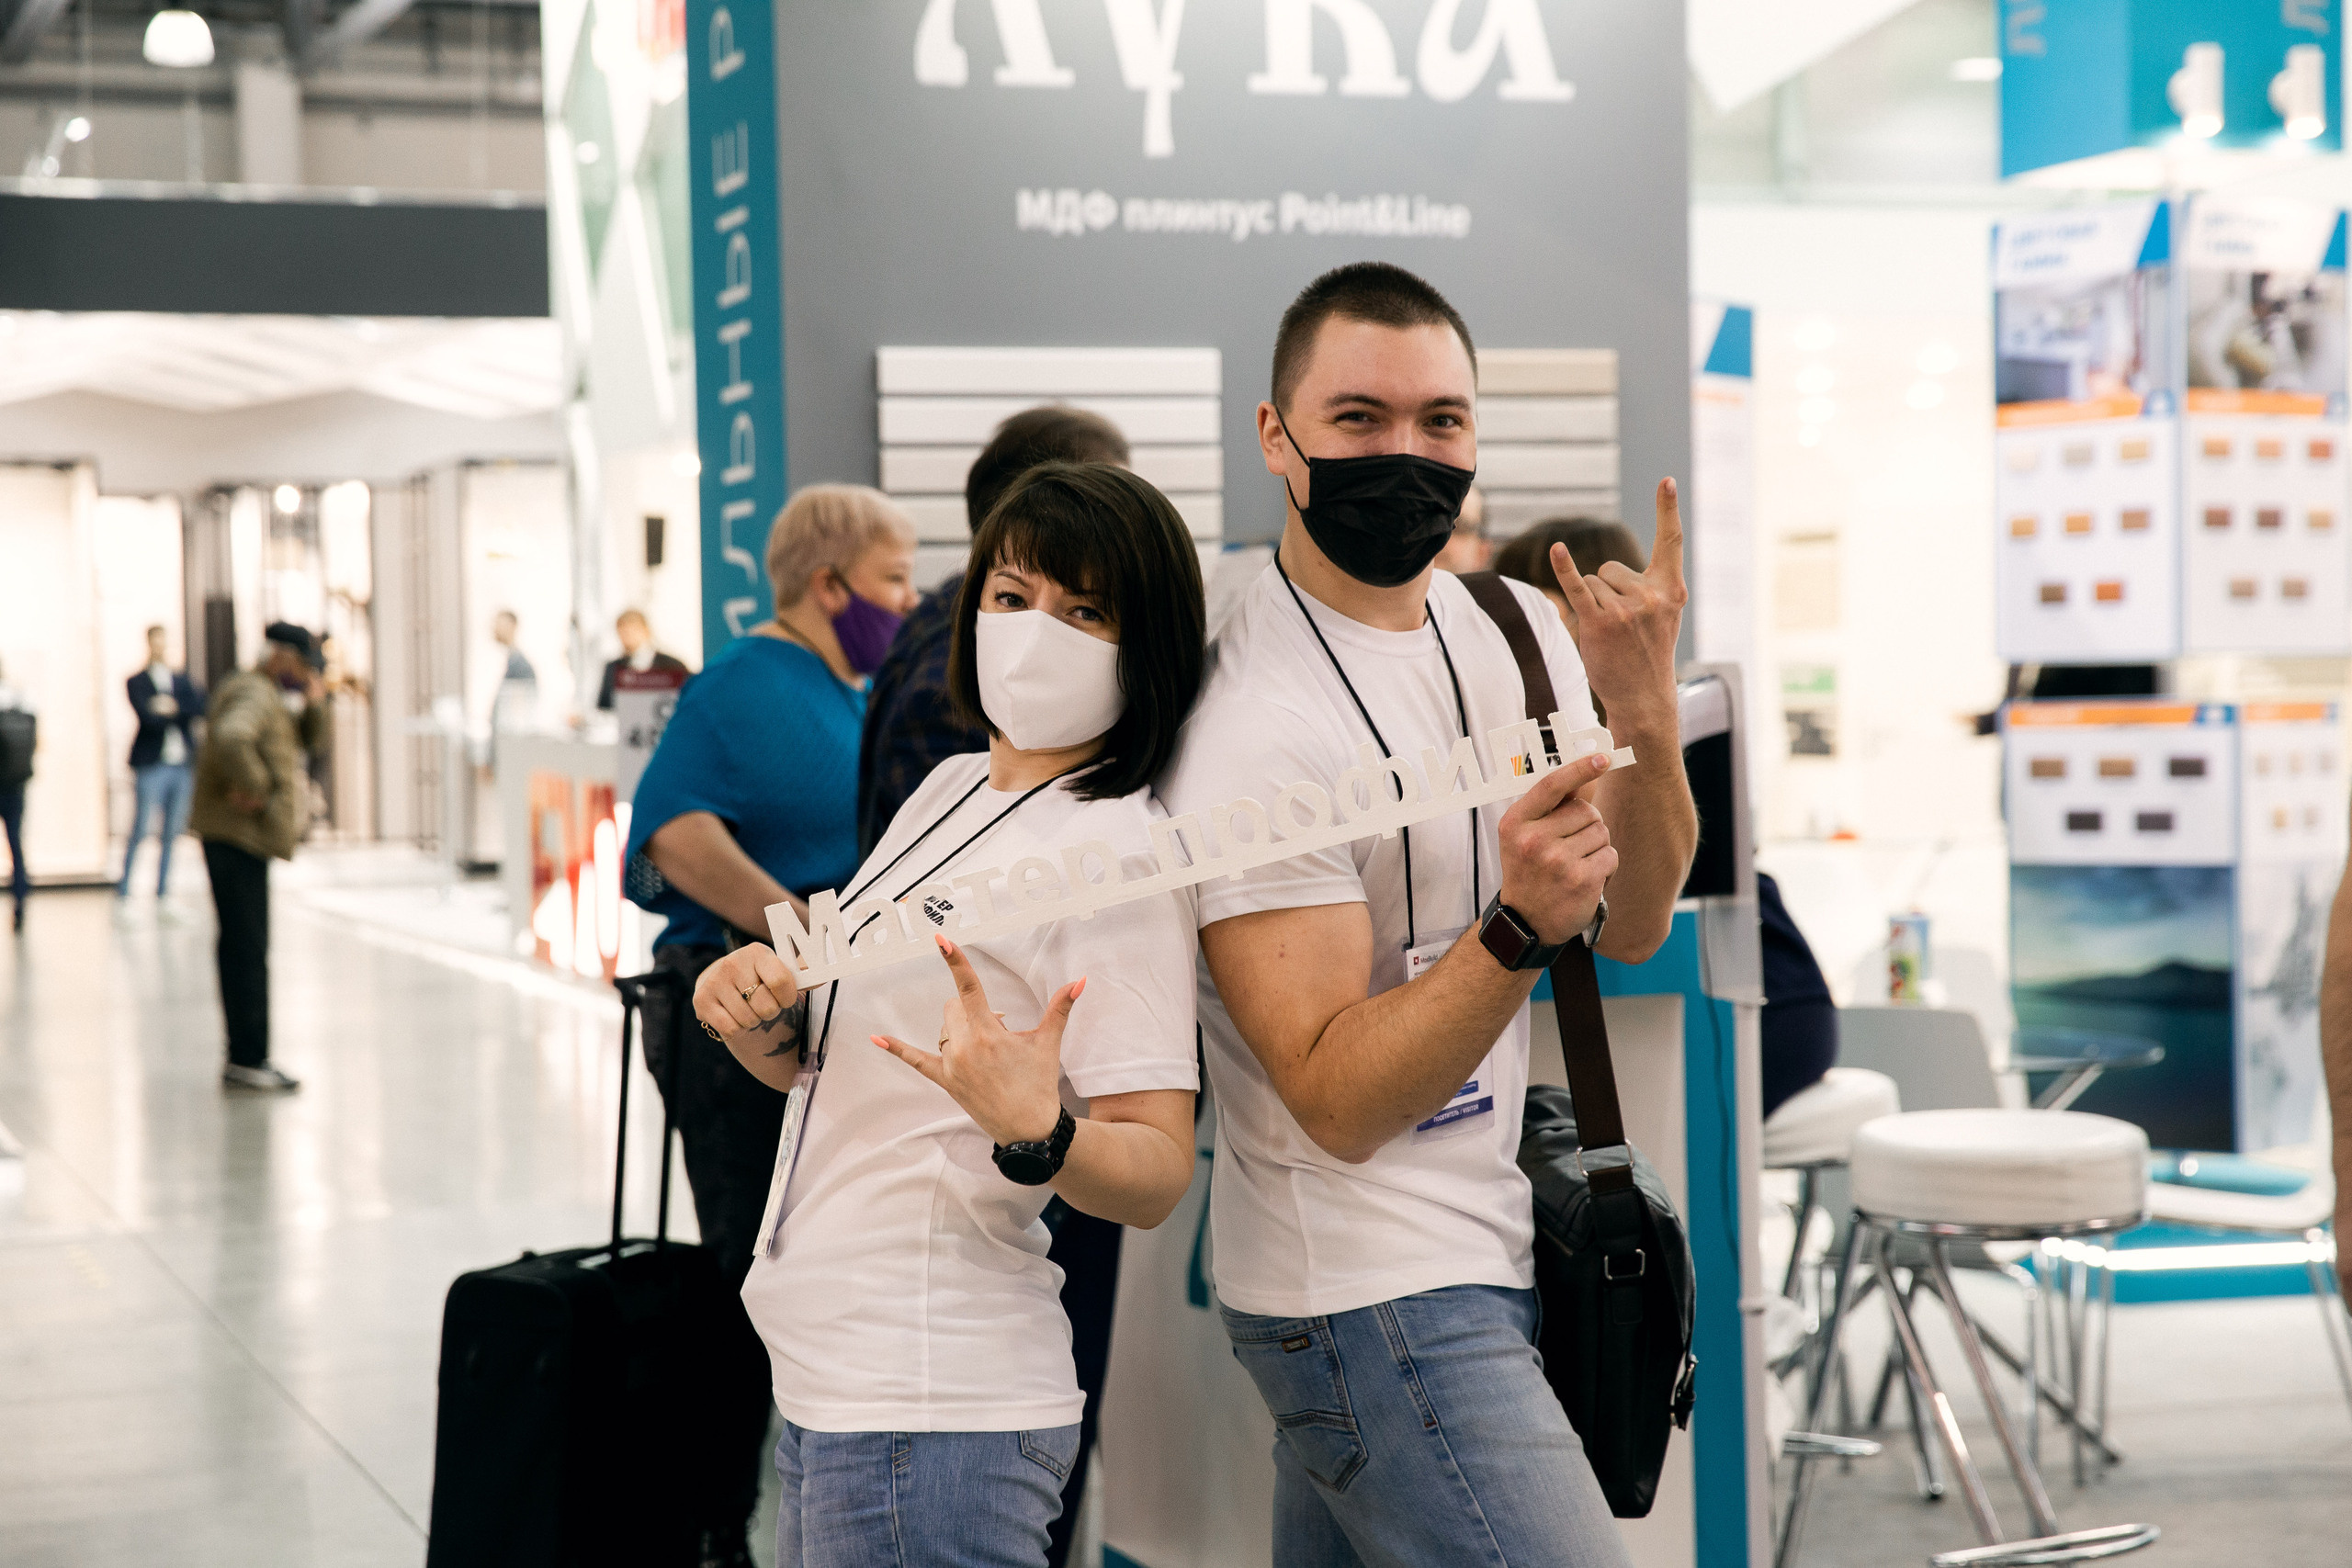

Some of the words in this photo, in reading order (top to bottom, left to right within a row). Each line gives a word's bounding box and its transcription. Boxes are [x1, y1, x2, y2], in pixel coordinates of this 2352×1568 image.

[1017, 188, 1118, 236] МДФ
[1123, 197, 1276, 243] плинтус
[1280, 190, 1471, 239] Point&Line
[763, 837, 1124, 970] Мастер
[1148, 710, 1616, 882] профиль
[1433, 1109, 1460, 1122] ПОСЕТИТЕЛЬ
[1462, 1104, 1479, 1114] VISITOR
